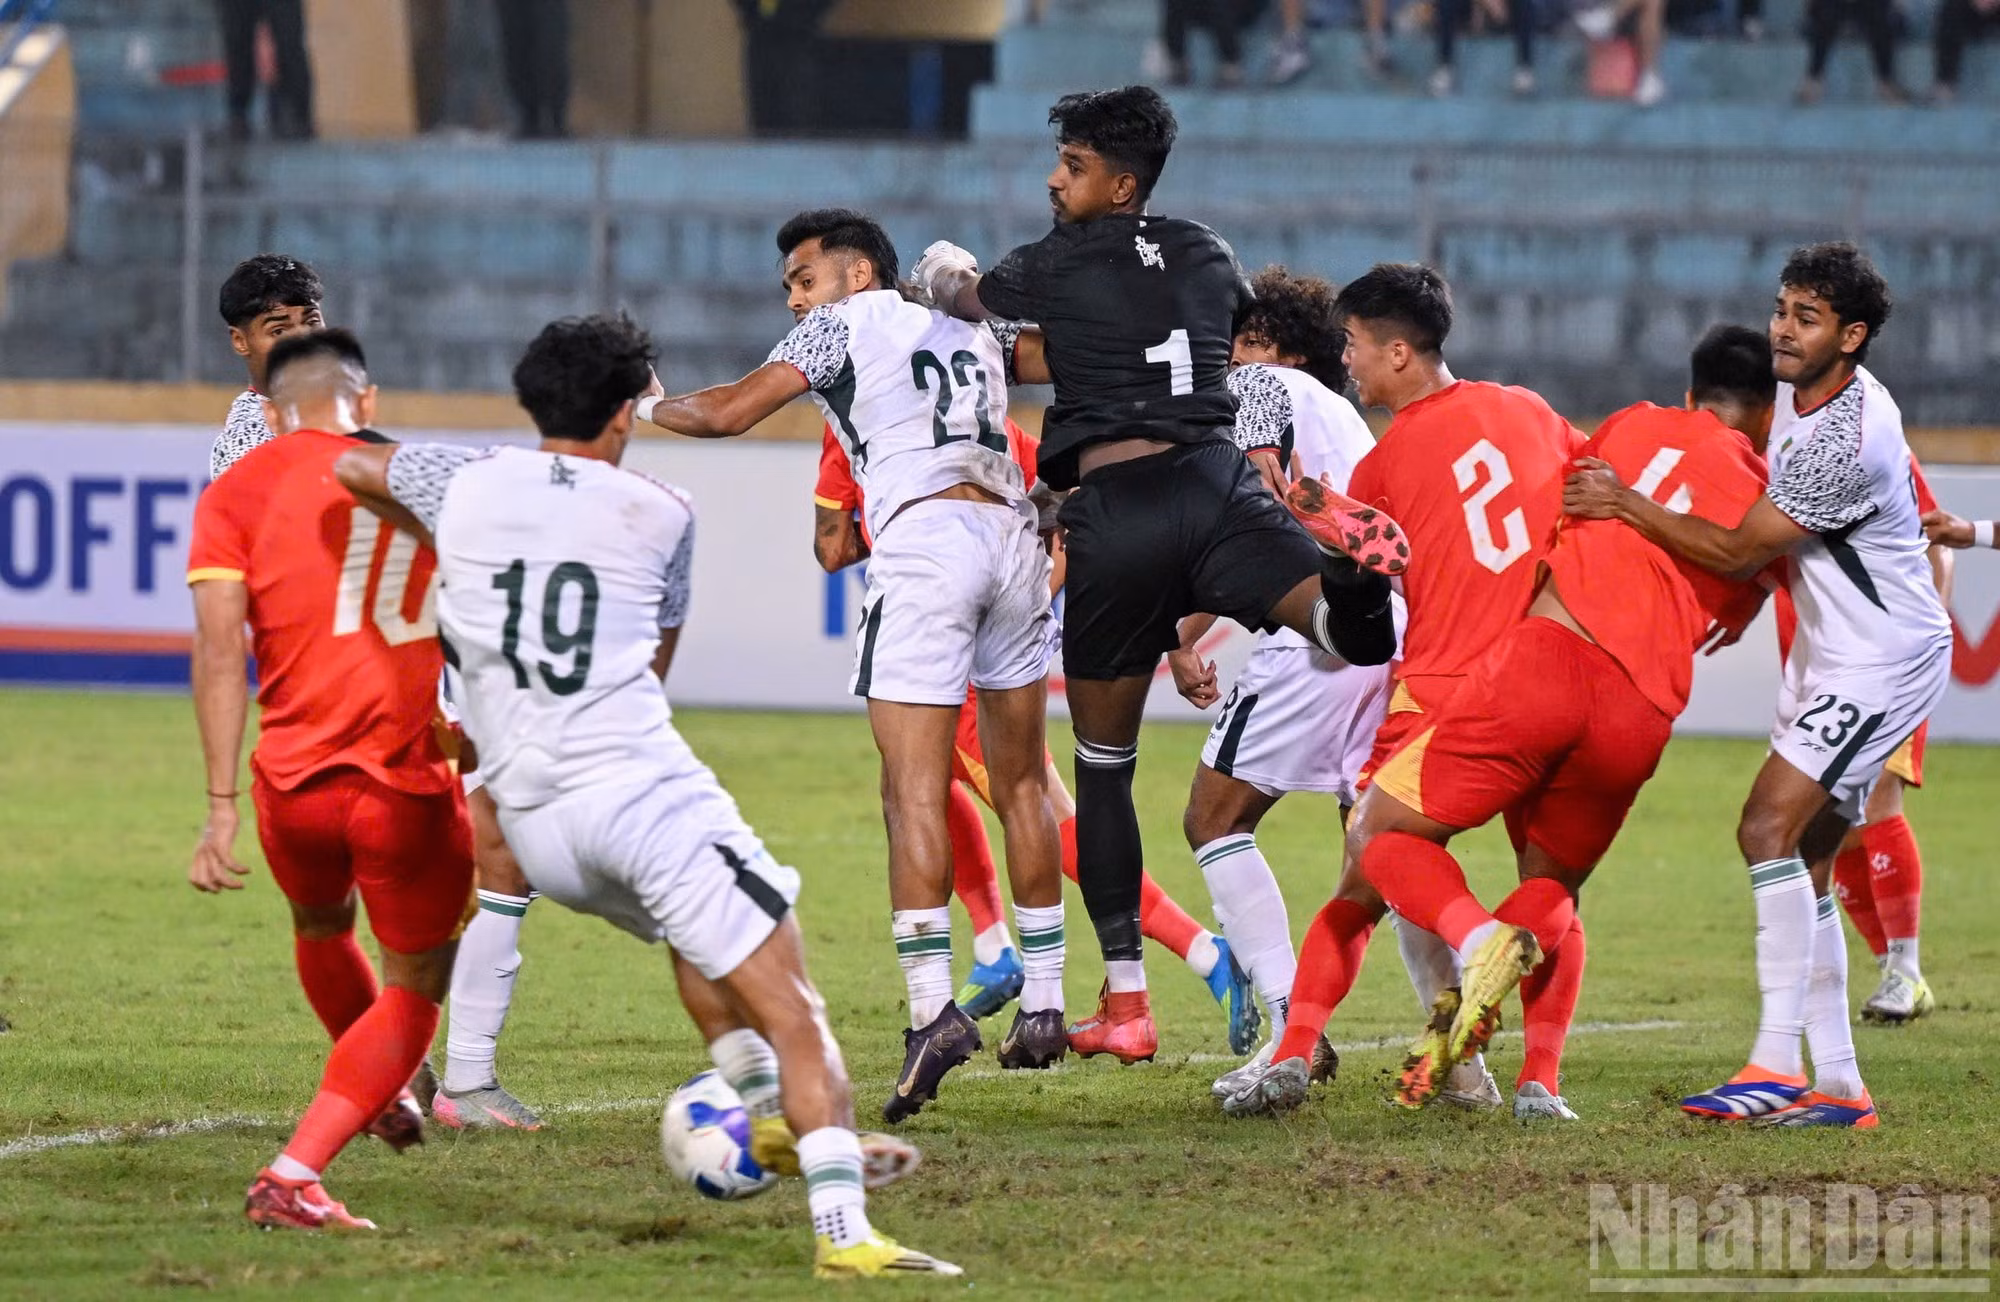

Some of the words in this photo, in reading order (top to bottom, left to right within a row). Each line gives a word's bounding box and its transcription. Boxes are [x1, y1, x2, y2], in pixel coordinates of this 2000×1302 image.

[911, 349, 1008, 454] 22
[1145, 329, 1193, 396] 1
[1451, 438, 1531, 575] 2
[491, 559, 599, 696] 19
[1795, 694, 1860, 748] 23
